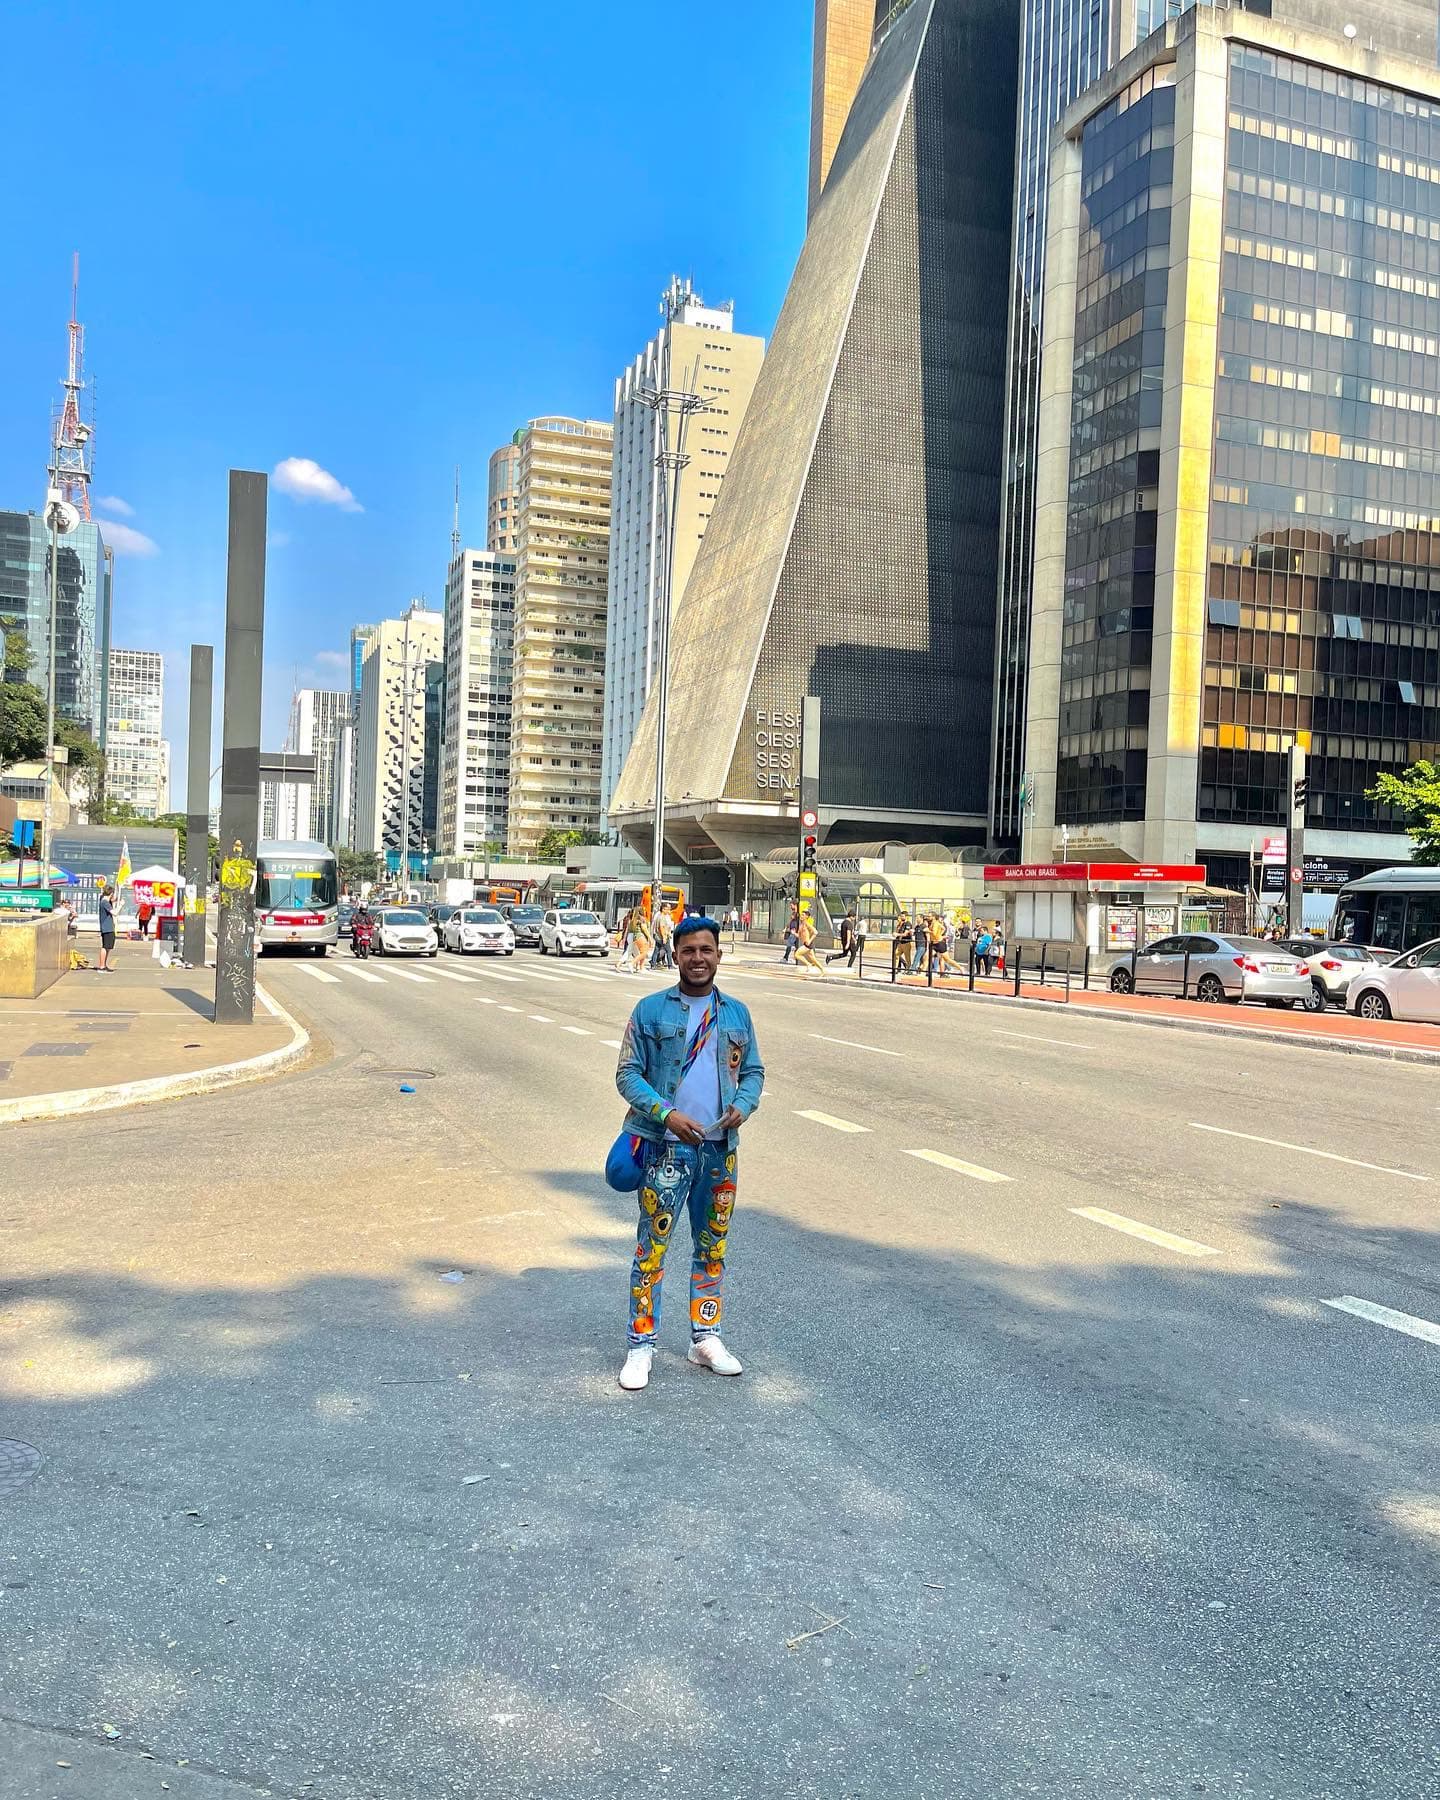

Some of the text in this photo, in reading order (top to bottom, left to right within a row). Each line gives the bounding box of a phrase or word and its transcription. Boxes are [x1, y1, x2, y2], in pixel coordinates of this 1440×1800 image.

[757, 752, 795, 769] SESI
[757, 772, 801, 789] SENA
[1005, 868, 1058, 877] BANCA CNN BRASIL
[152, 881, 175, 898] 13
